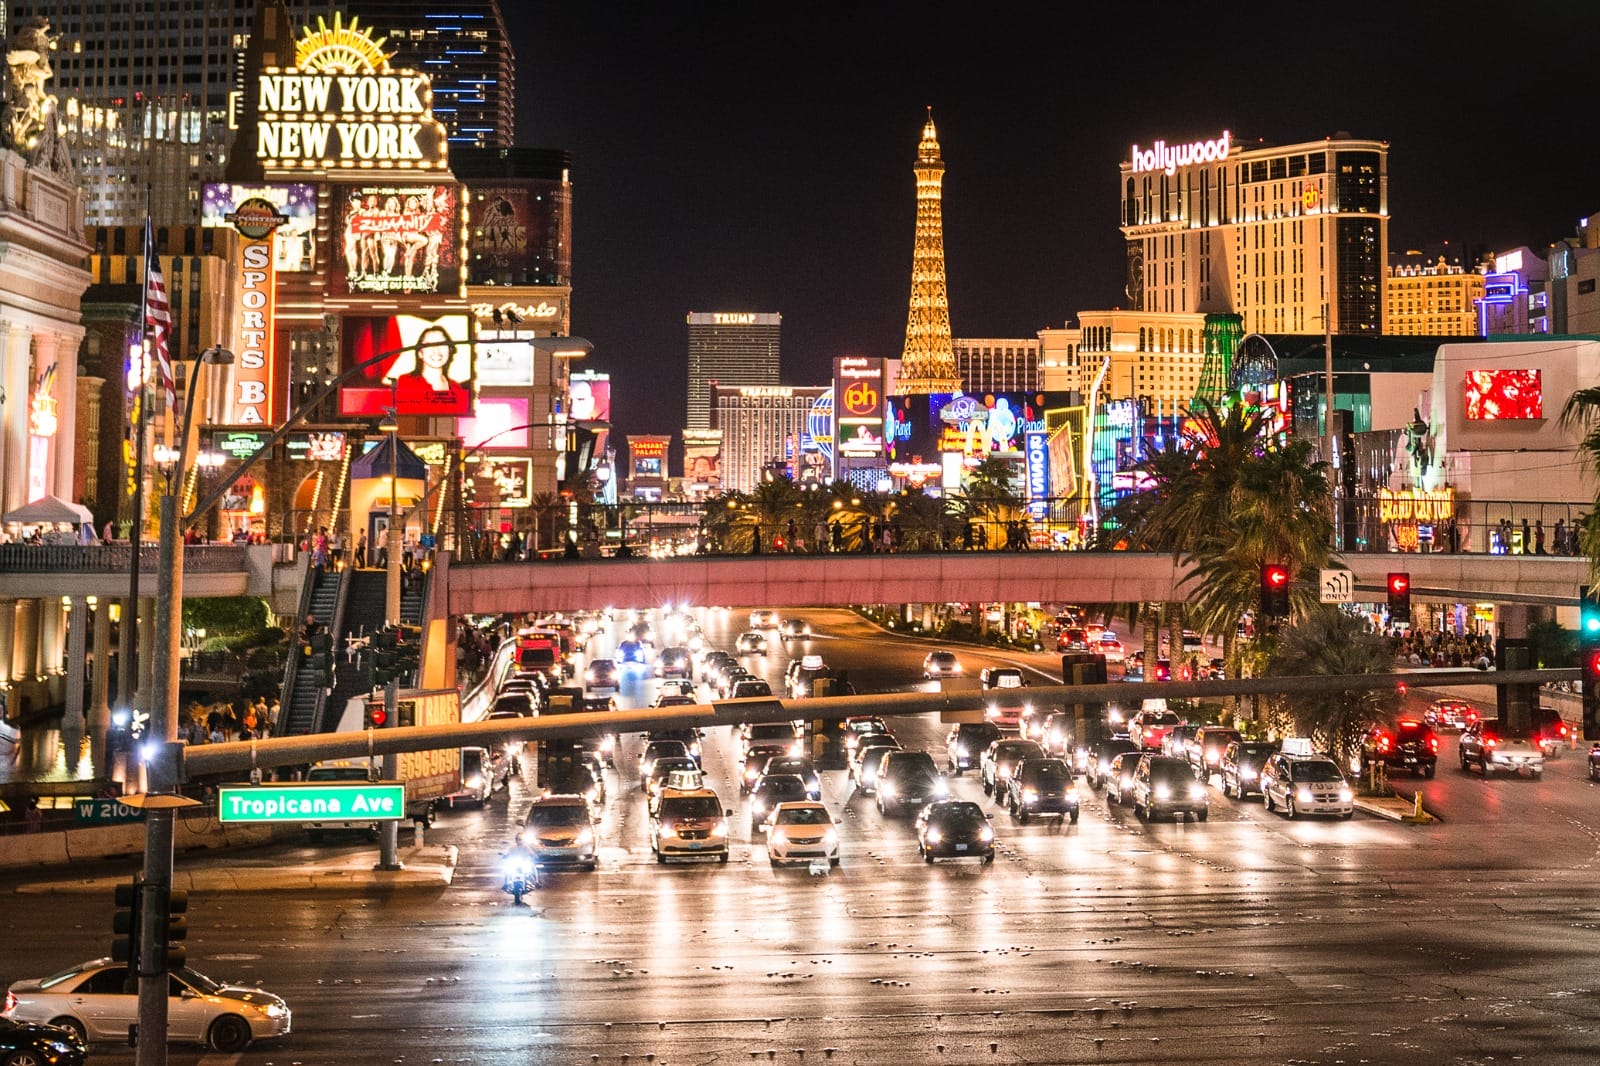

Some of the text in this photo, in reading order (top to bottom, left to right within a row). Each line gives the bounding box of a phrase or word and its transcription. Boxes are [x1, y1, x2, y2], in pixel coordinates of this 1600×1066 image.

[258, 76, 425, 114] NEW YORK
[257, 121, 424, 160] NEW YORK
[1132, 130, 1230, 176] hollywood
[359, 213, 433, 232] ZUMANITY
[241, 246, 268, 369] SPORTS
[499, 302, 558, 319] Carlo
[714, 313, 755, 324] TRUMP
[848, 383, 877, 409] ph
[1030, 436, 1045, 493] ROSS
[1380, 487, 1412, 523] GRAND
[80, 802, 142, 818] W 2100
[228, 794, 394, 817] Tropicana Ave
